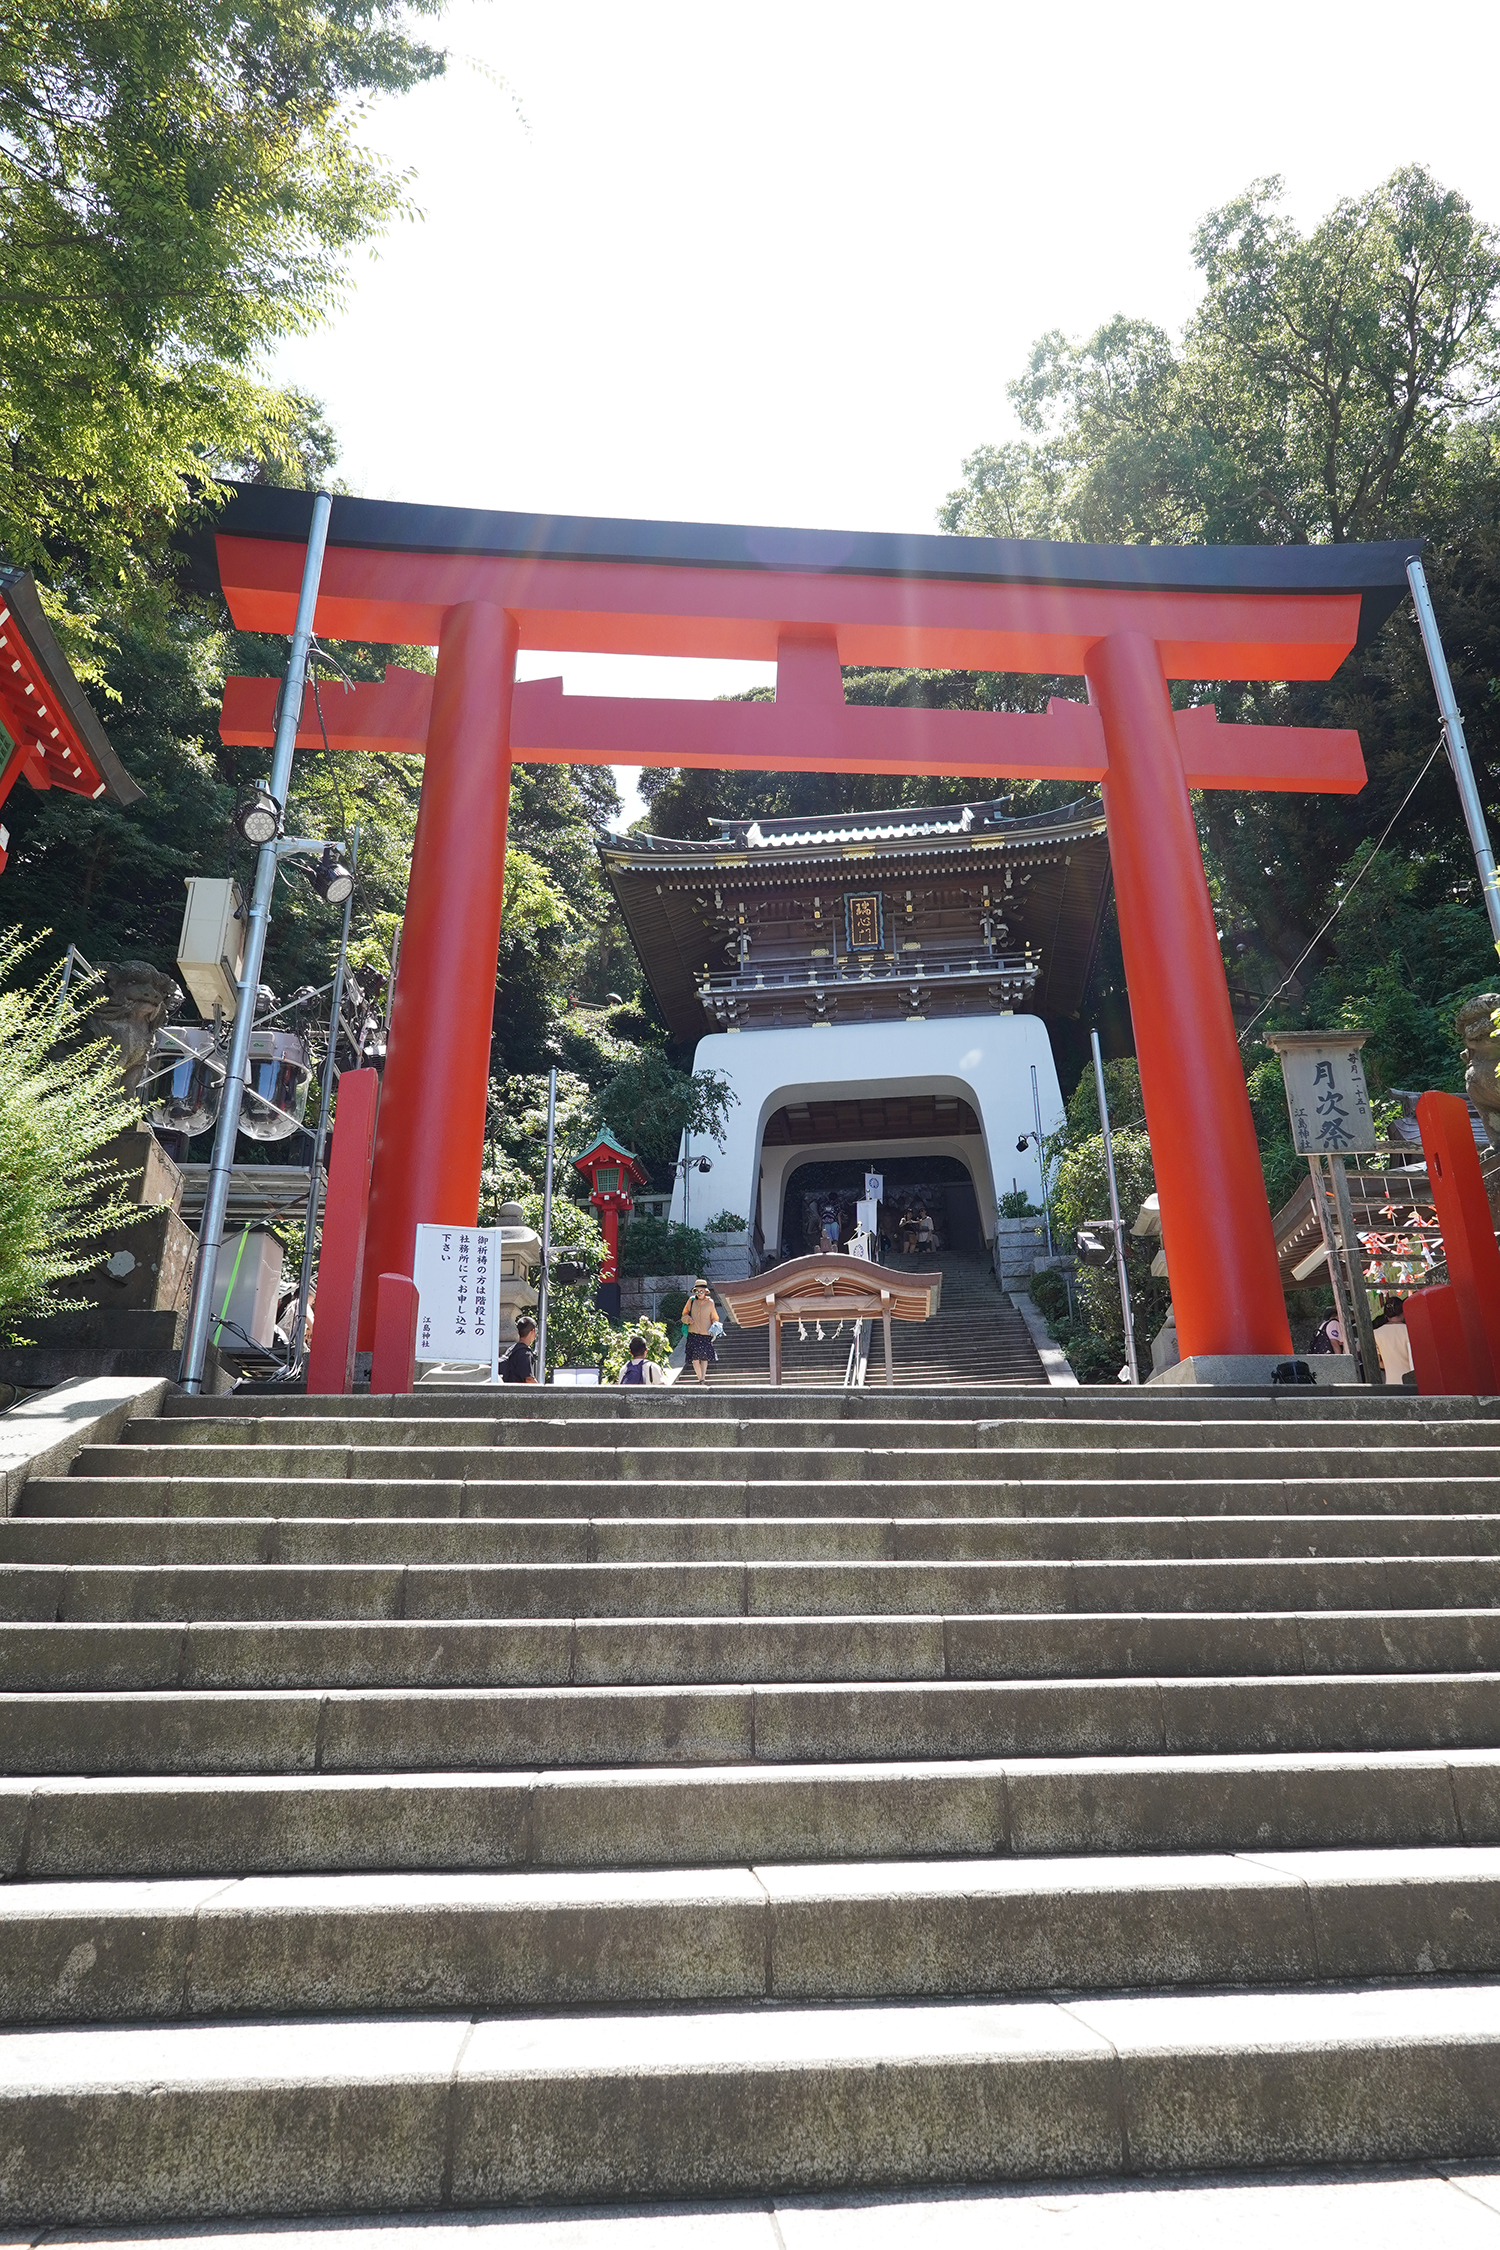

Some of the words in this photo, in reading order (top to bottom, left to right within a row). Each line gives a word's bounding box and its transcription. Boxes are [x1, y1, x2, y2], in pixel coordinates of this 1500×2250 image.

[855, 901, 872, 942] 瑞心門
[1313, 1061, 1355, 1150] 月次祭
[1294, 1108, 1312, 1149] 江島神社
[441, 1233, 452, 1261] 下さい
[455, 1234, 470, 1336] 社務所にてお申し込み
[474, 1235, 489, 1336] 御祈祷の方は階段上の
[421, 1316, 431, 1348] 江島神社
